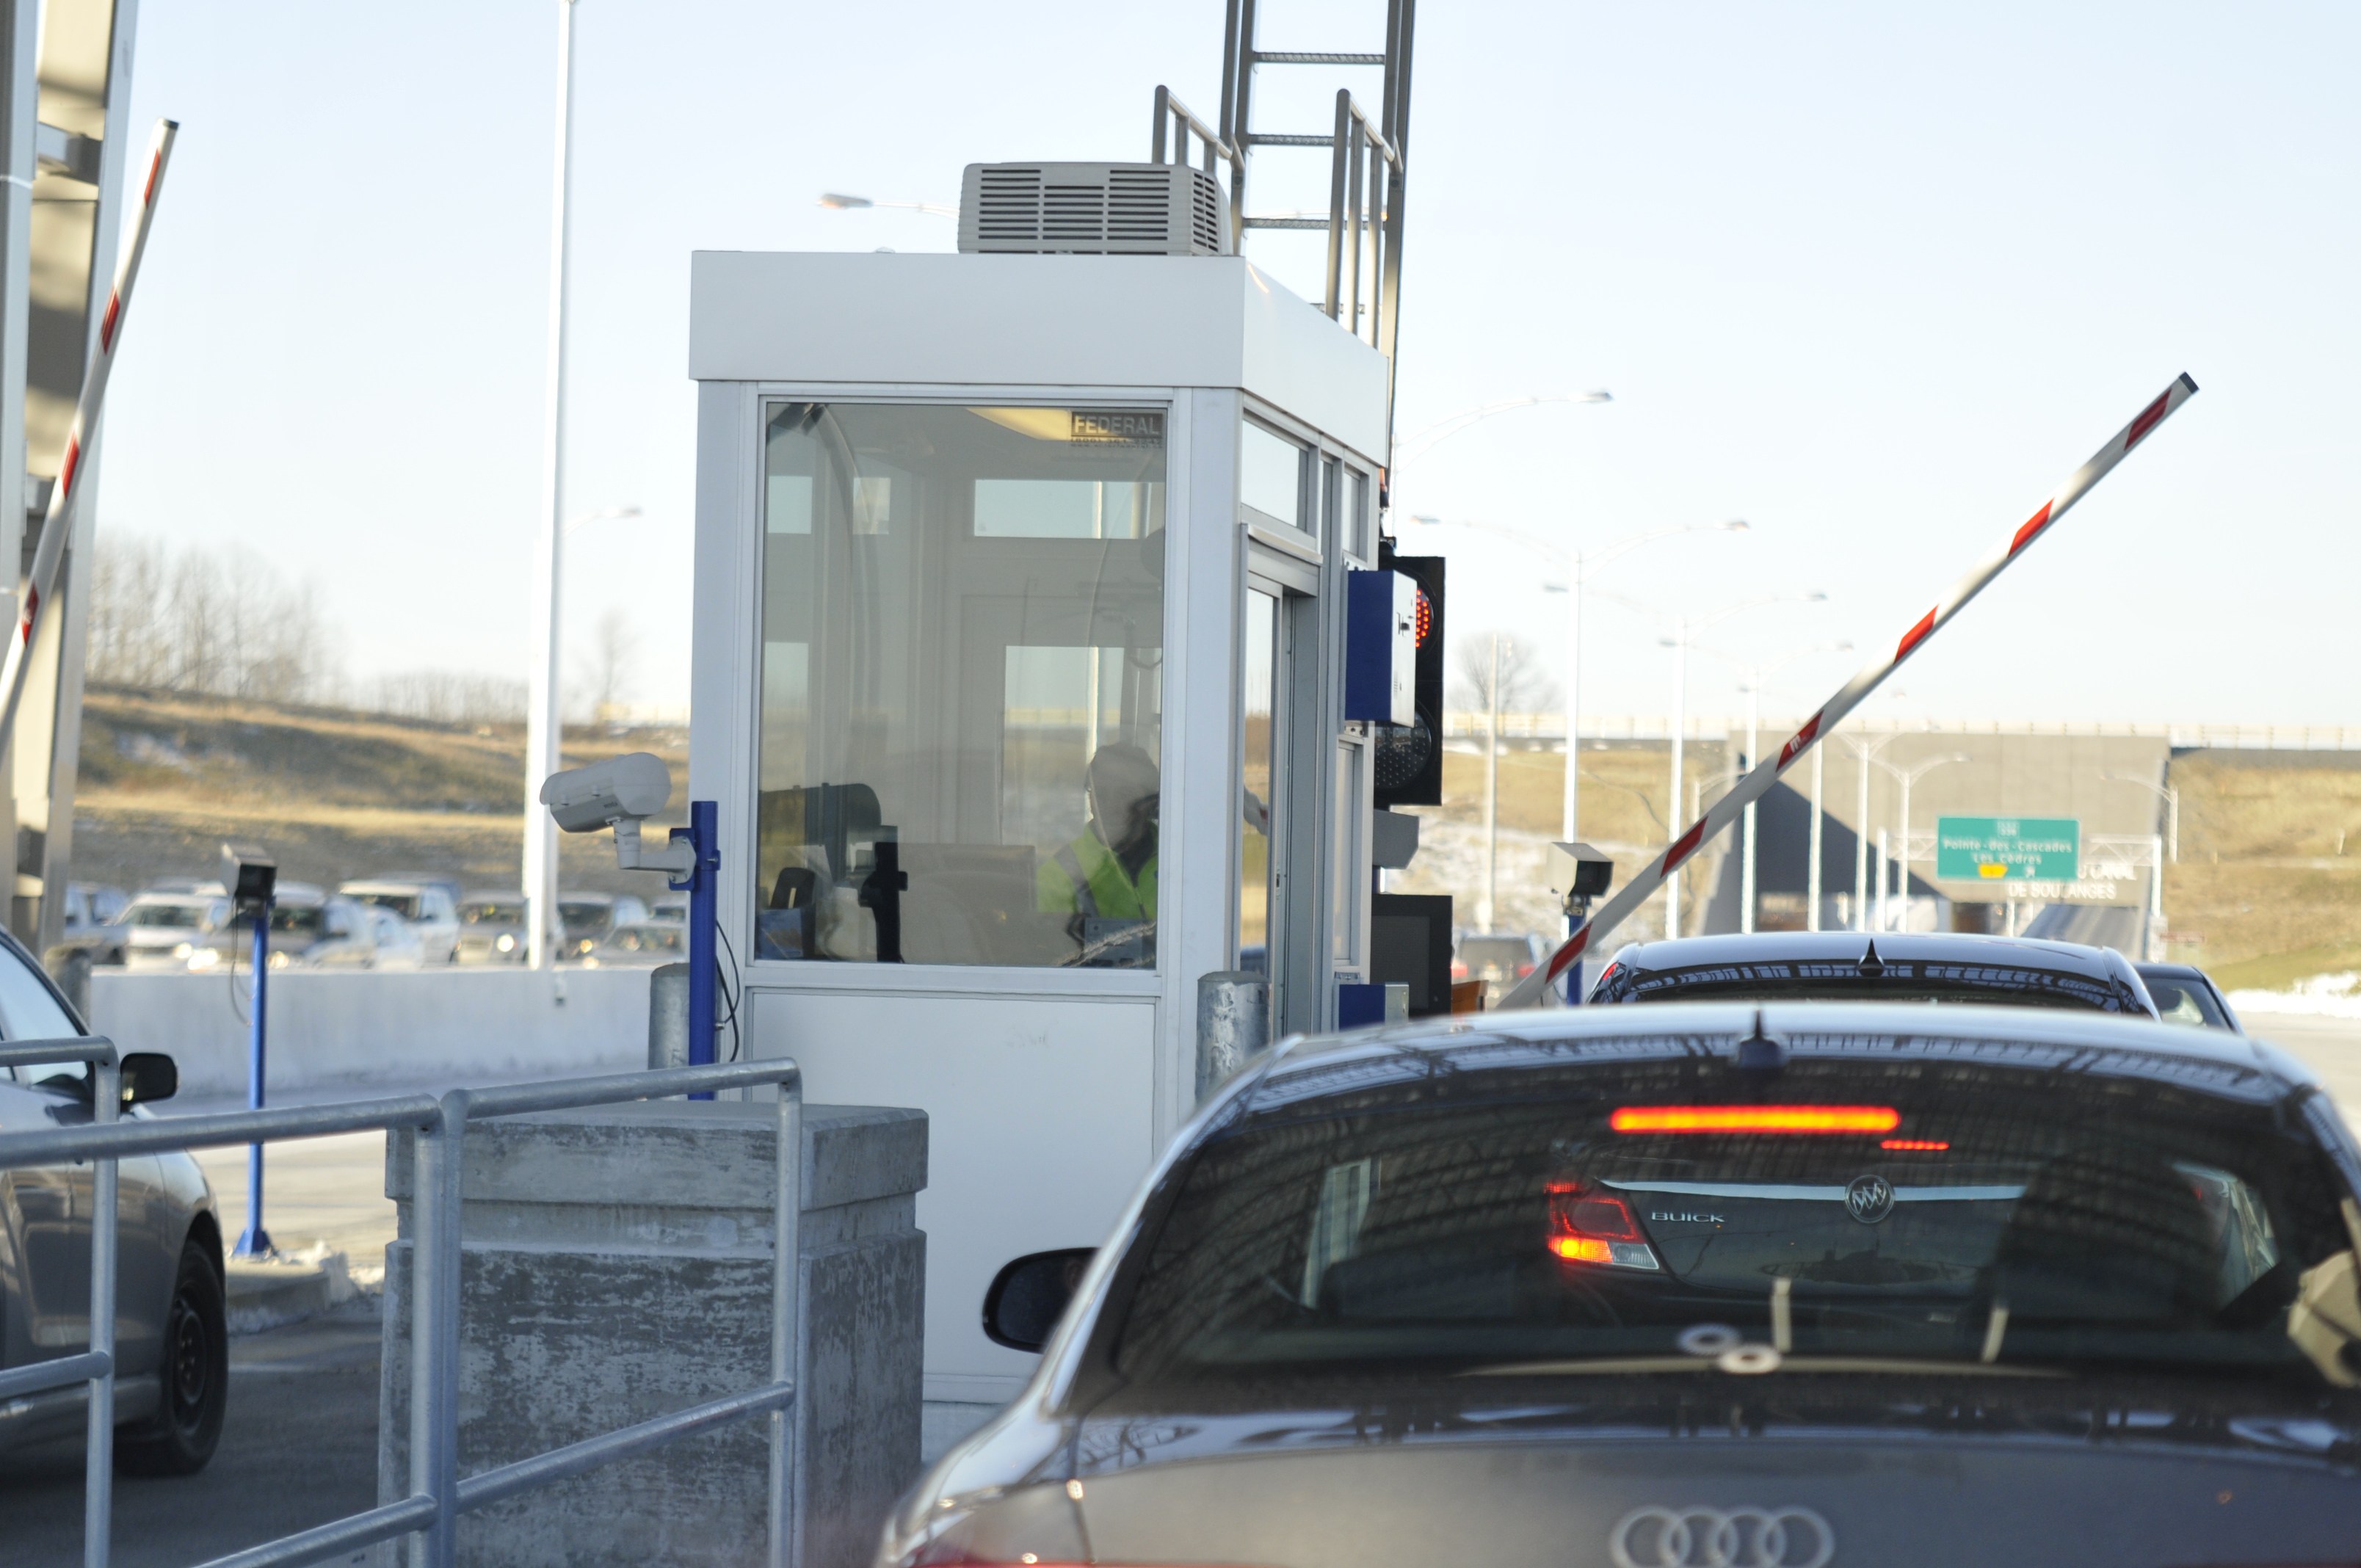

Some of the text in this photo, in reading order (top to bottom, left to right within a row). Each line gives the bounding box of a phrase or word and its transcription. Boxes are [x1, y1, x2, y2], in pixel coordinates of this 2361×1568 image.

[1075, 415, 1159, 435] FEDERAL
[1972, 852, 1995, 864] Les
[2009, 882, 2027, 897] DE
[1651, 1211, 1725, 1222] BUICK
